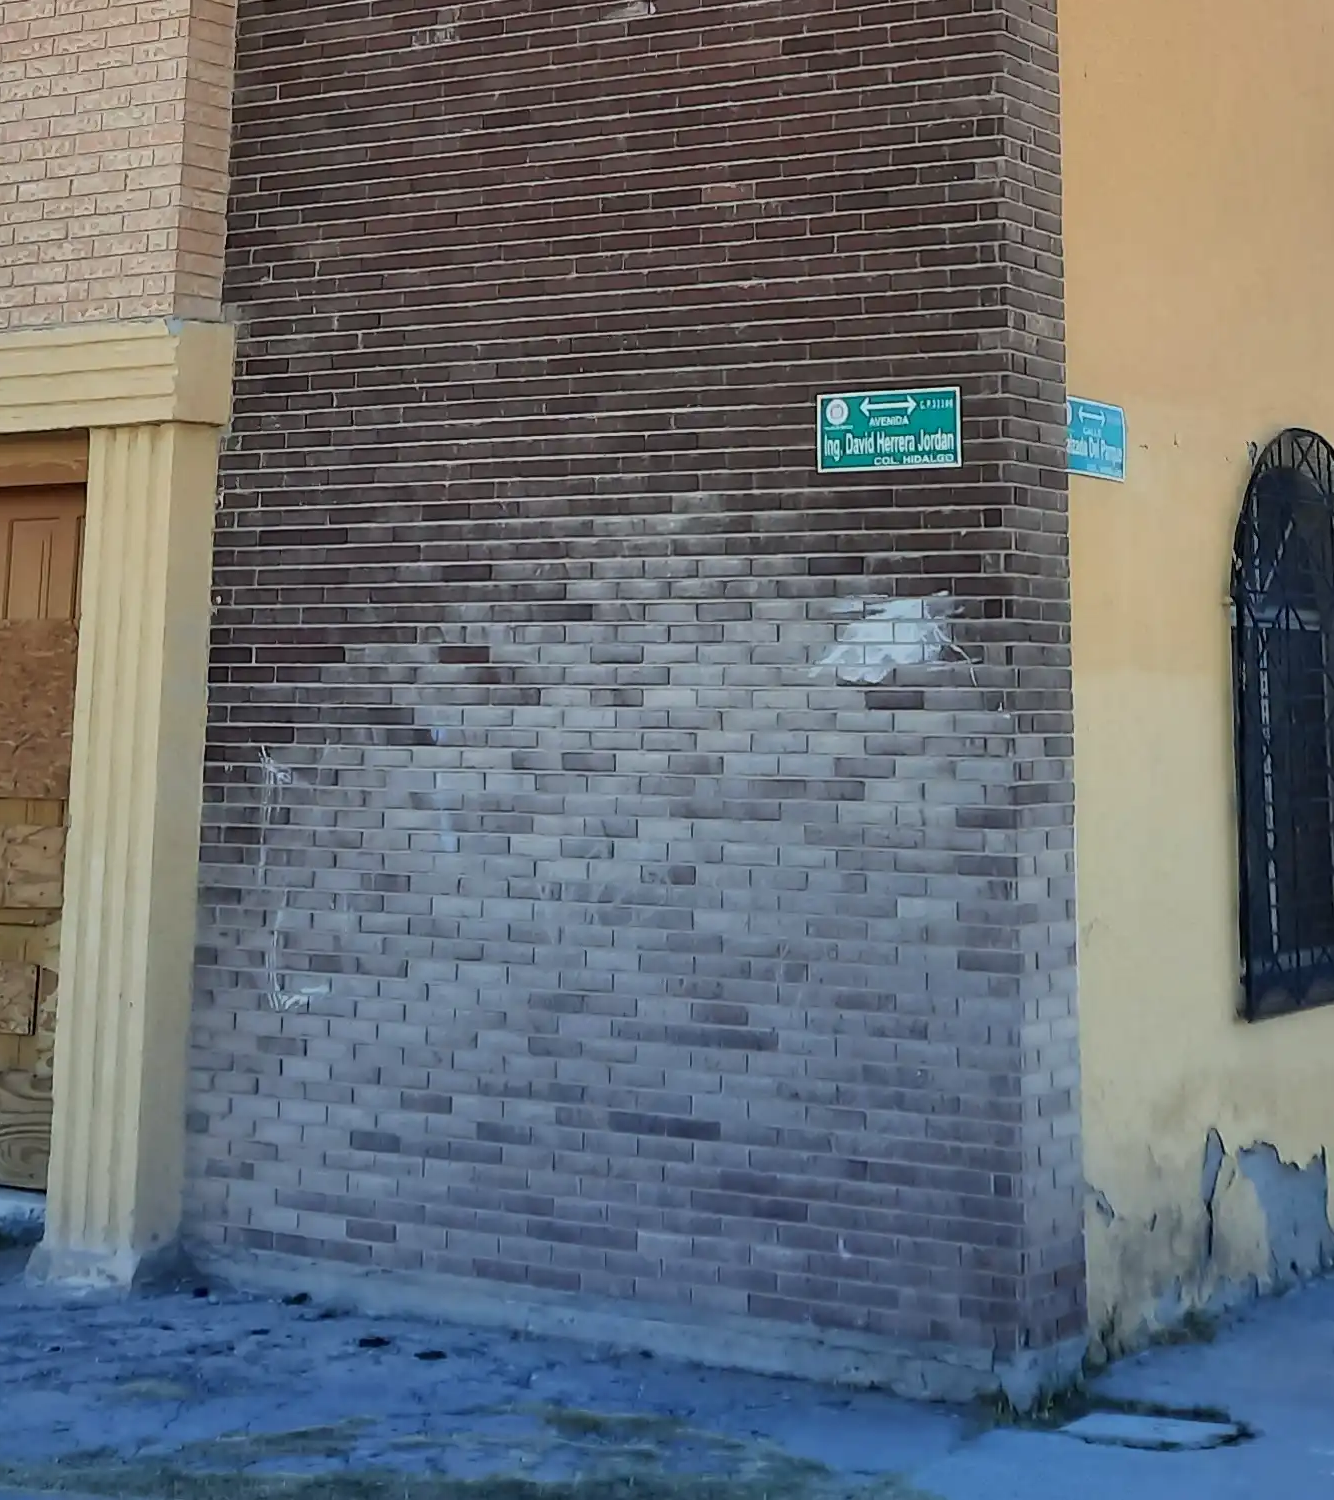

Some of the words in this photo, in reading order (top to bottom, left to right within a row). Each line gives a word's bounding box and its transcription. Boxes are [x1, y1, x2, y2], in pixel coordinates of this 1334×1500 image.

[869, 415, 909, 427] AVENIDA
[824, 434, 843, 462] Ing.
[845, 432, 875, 455] David
[876, 431, 916, 453] Herrera
[917, 428, 954, 451] Jordan
[874, 456, 900, 466] COL.
[902, 454, 954, 464] HIDALGO
